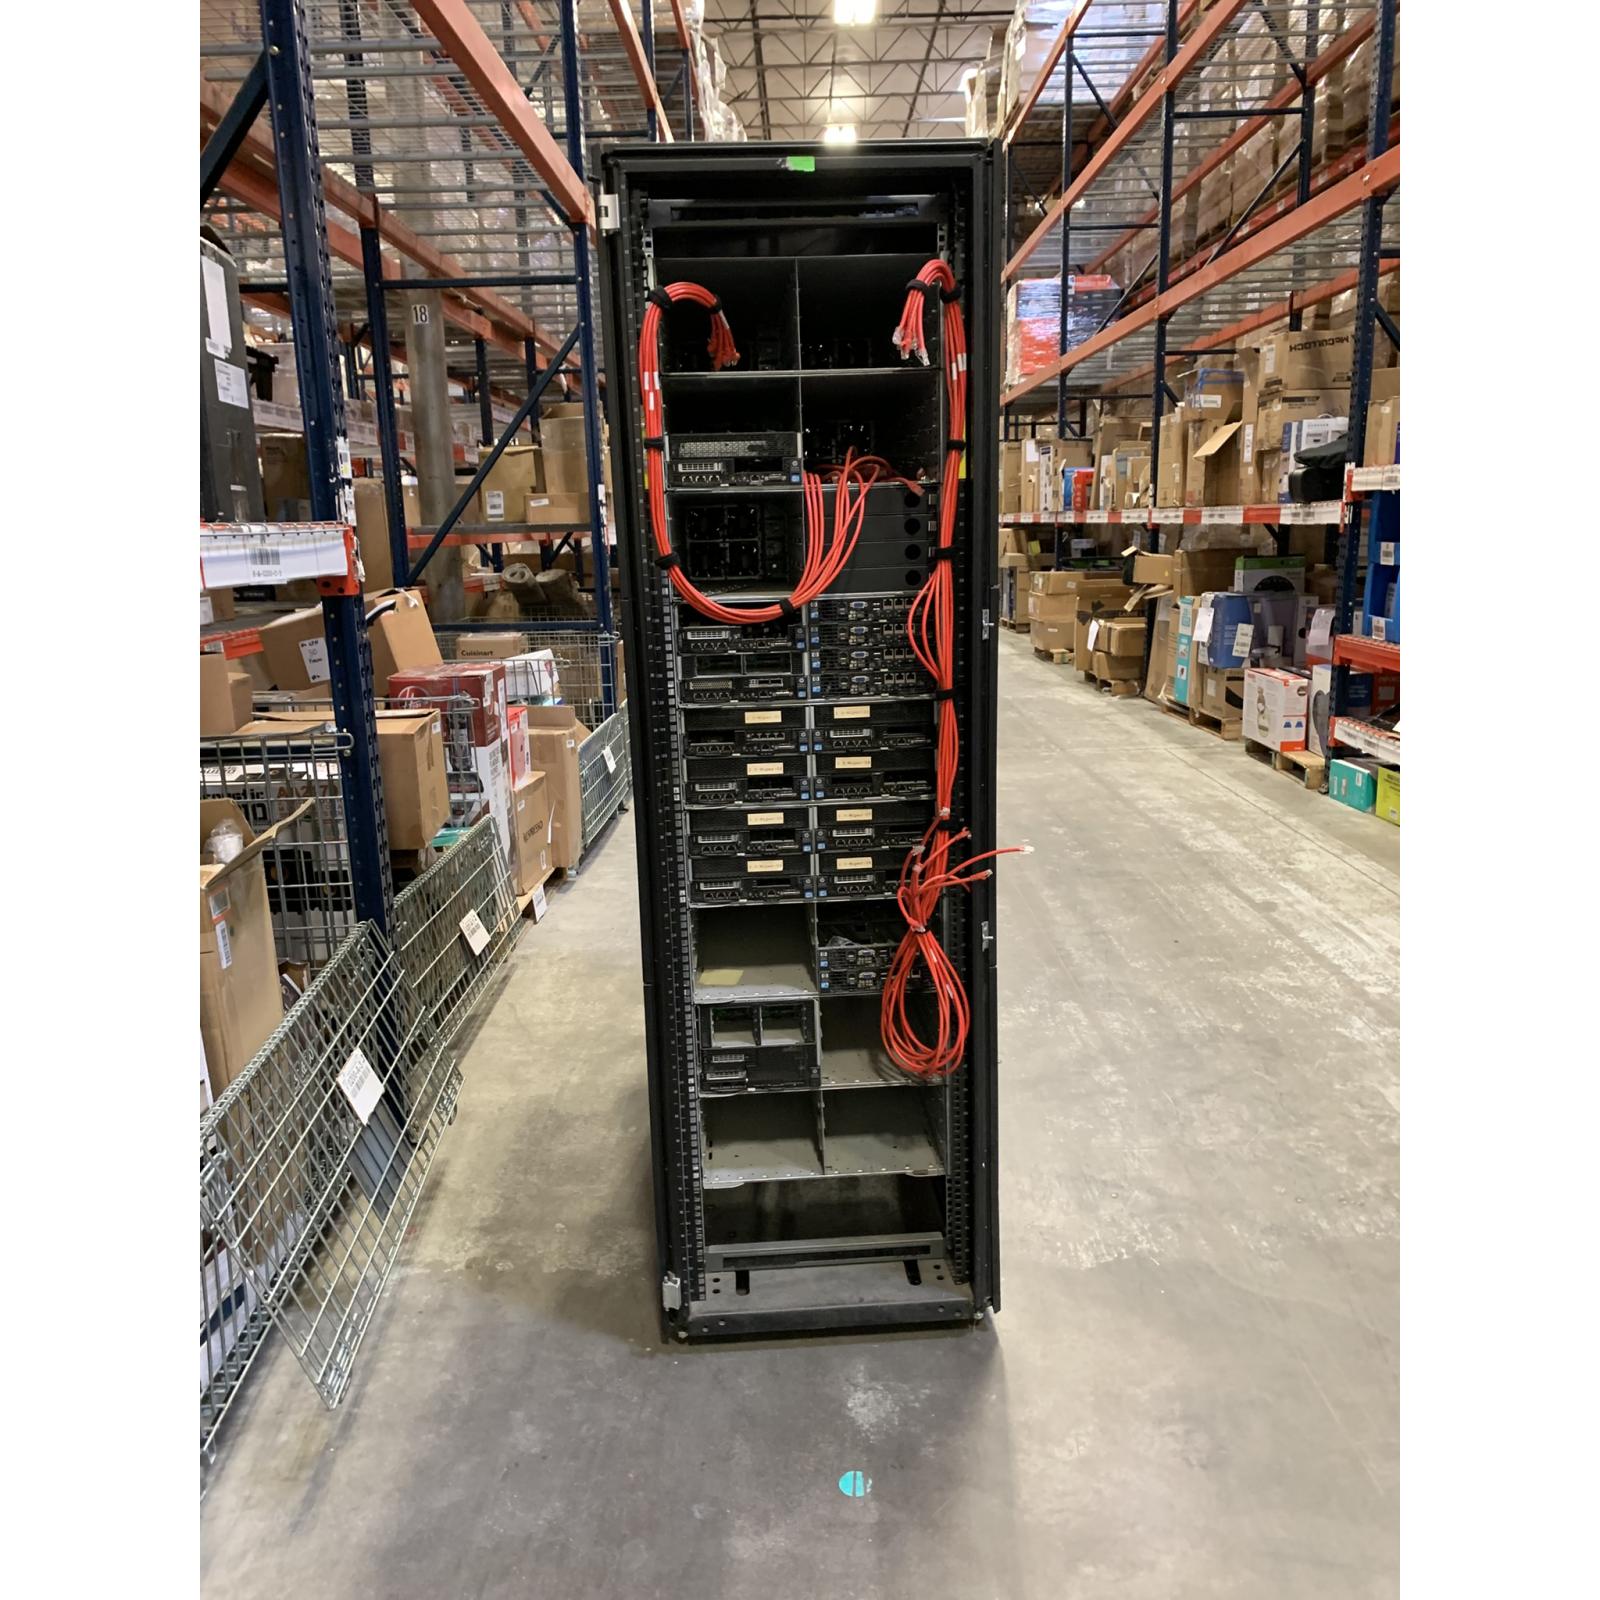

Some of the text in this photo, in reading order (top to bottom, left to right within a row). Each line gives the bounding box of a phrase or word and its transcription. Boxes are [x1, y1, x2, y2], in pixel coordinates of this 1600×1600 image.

[413, 305, 428, 323] 18
[1289, 336, 1349, 352] McCULLOCH
[461, 649, 494, 657] Cuisinart
